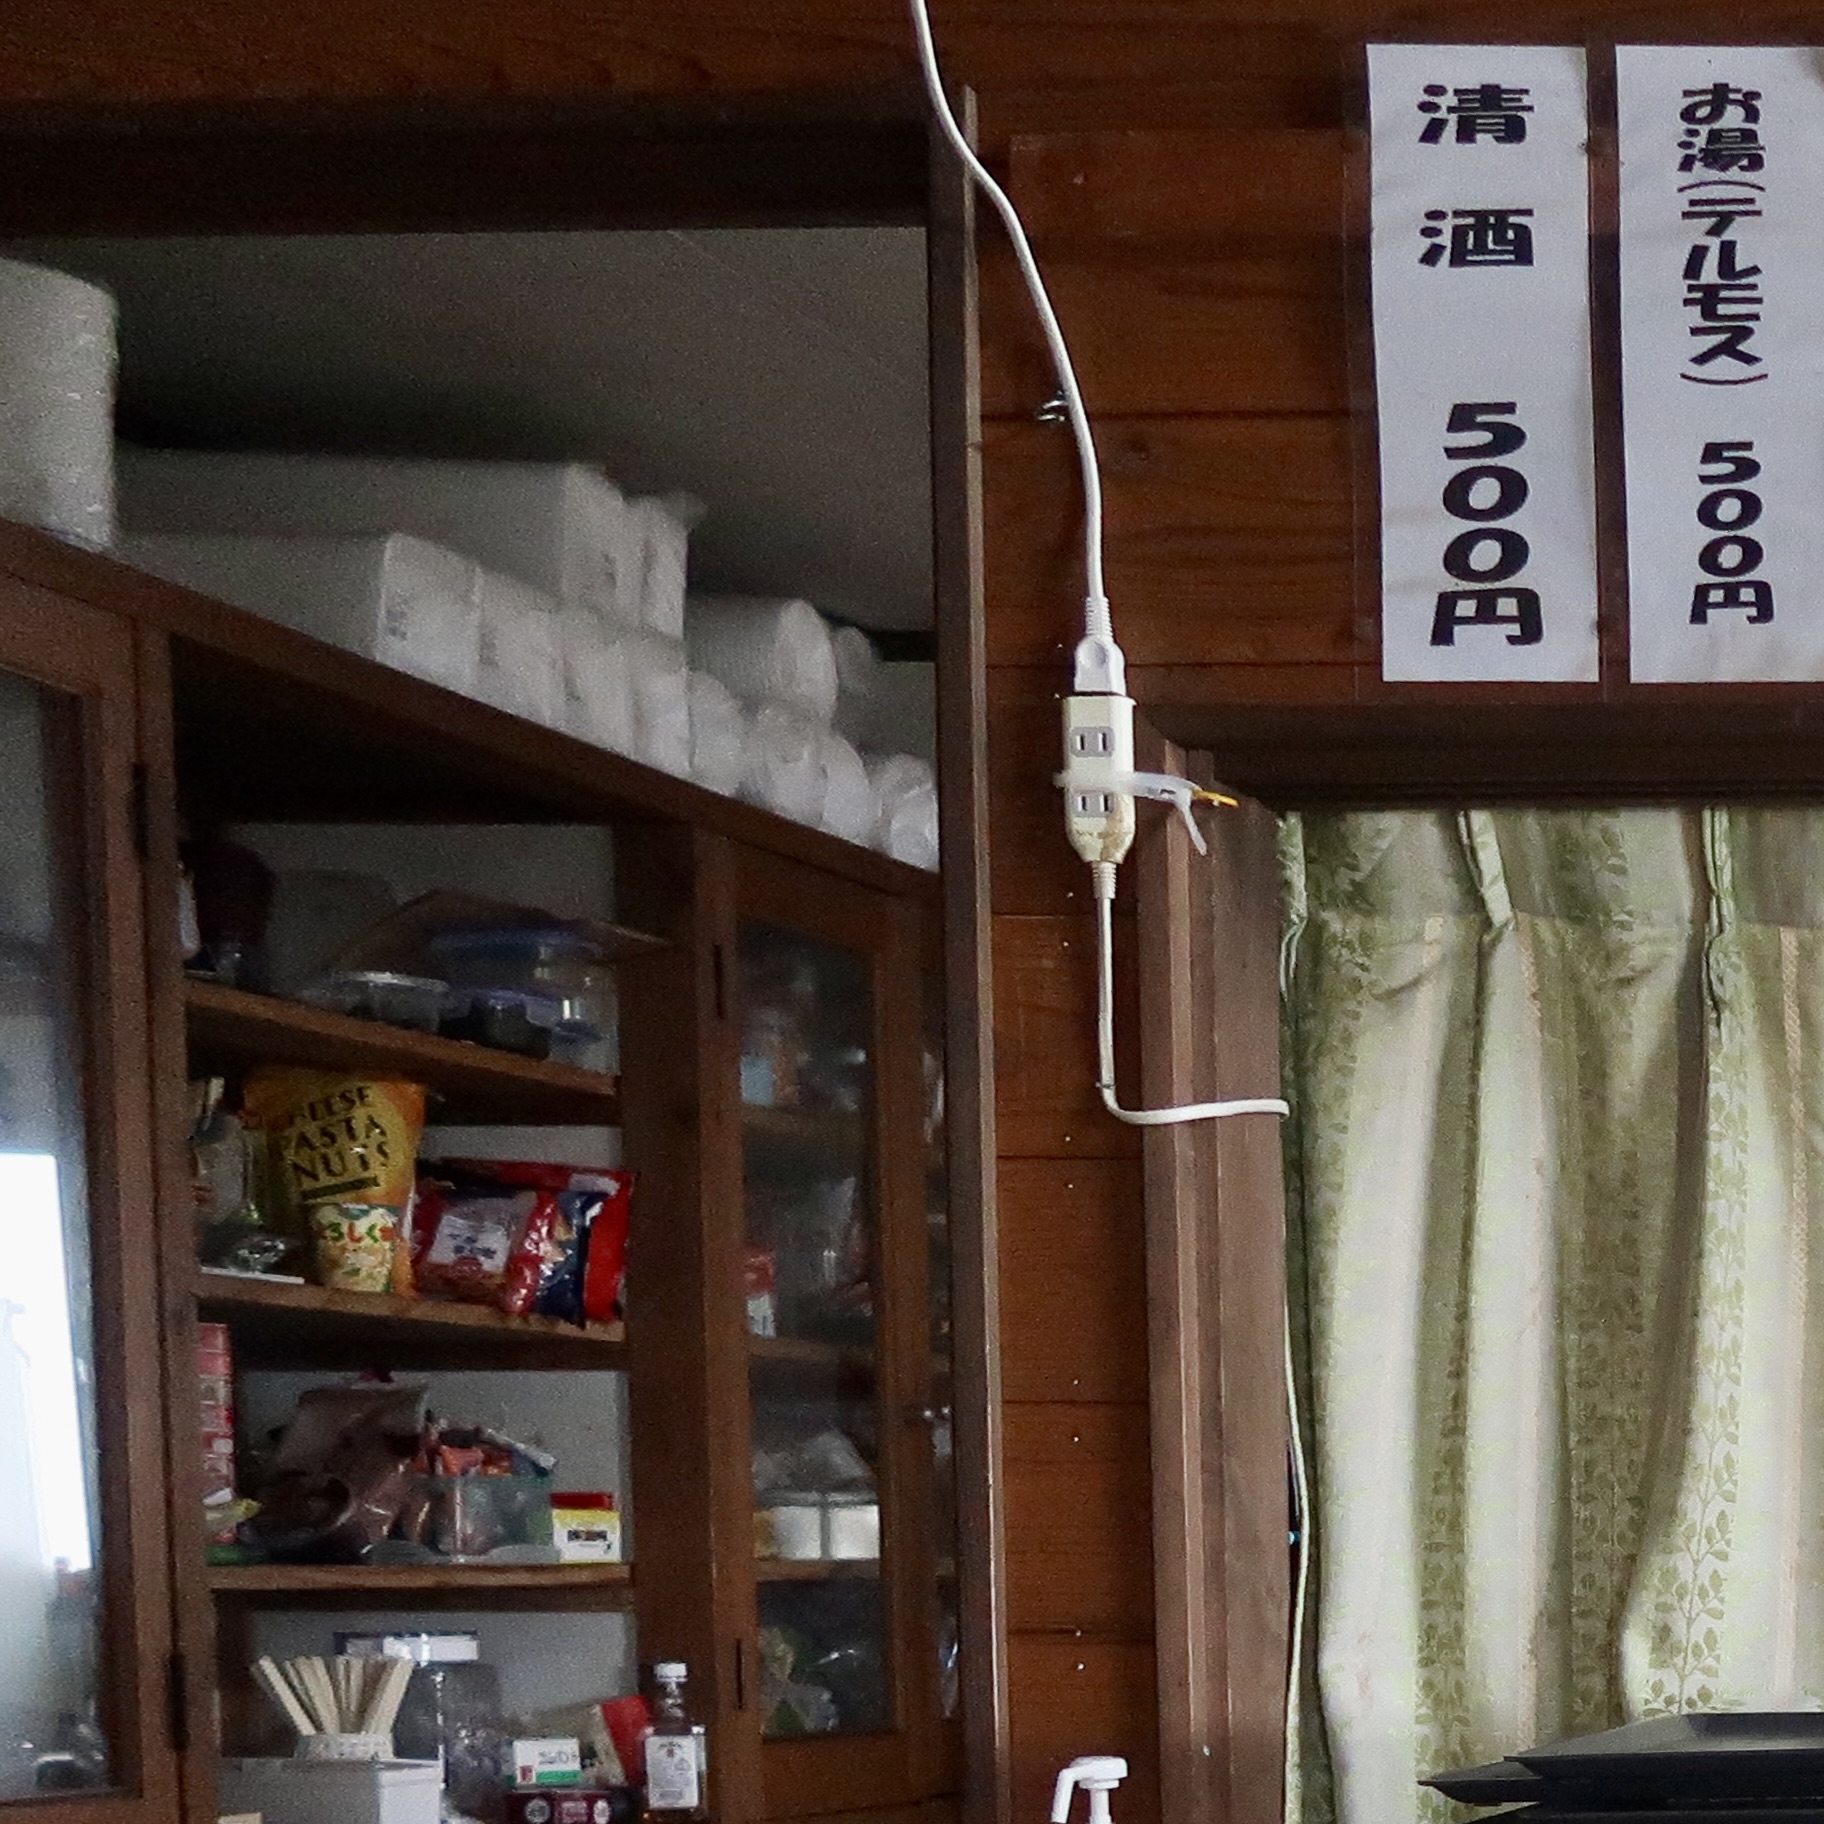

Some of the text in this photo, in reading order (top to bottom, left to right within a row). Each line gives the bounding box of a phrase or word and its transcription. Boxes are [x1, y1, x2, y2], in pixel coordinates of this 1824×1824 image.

[1430, 402, 1543, 647] 500円
[1690, 441, 1775, 627] 500円
[291, 1140, 392, 1187] NUTS
